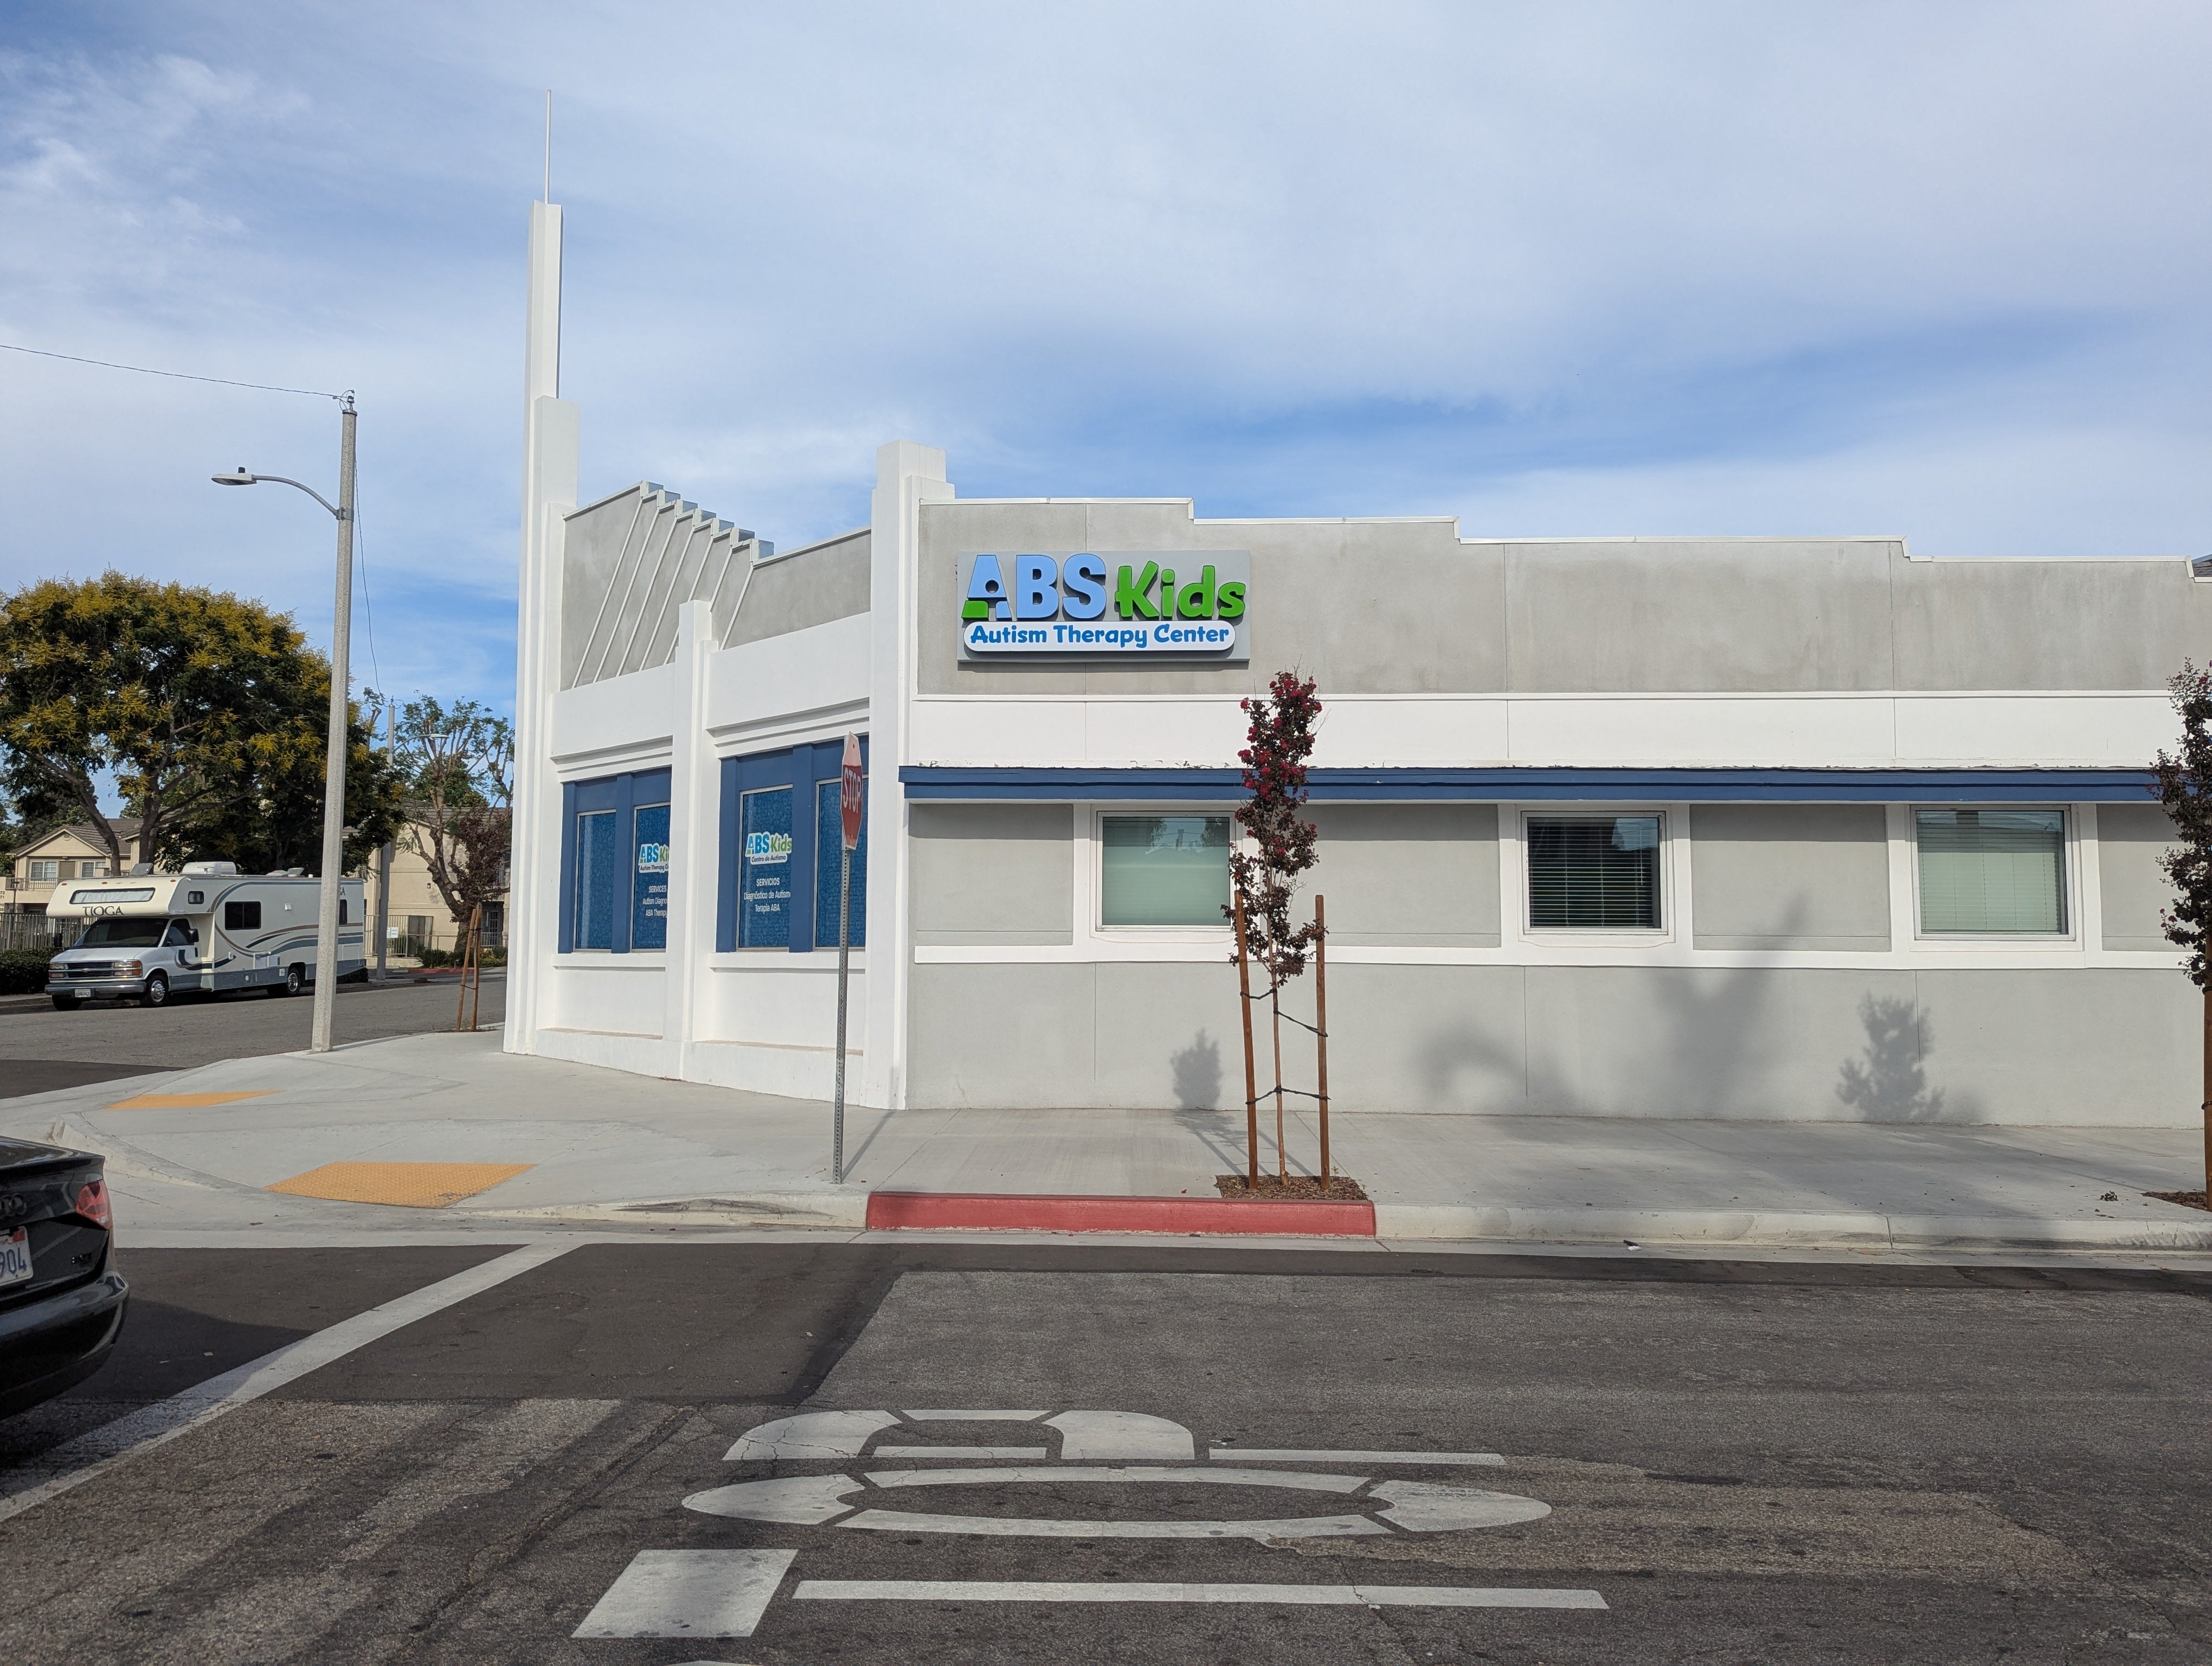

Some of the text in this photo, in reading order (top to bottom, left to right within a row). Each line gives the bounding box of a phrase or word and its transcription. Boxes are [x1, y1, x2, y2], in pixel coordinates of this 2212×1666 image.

[961, 553, 1245, 619] ABS Kids
[970, 624, 1230, 648] Autism Therapy Center
[843, 767, 861, 814] STOP
[746, 834, 792, 855] ABS Kids
[640, 844, 669, 863] ABS Ki
[648, 885, 667, 893] SERVICES
[756, 877, 780, 887] SERVICIOS
[655, 896, 667, 906] Diagno
[743, 889, 791, 902] Diagnóstico de Autism
[82, 905, 125, 917] TIOGA
[755, 904, 780, 914] Terapia ABA
[571, 1410, 1609, 1666] TOP
